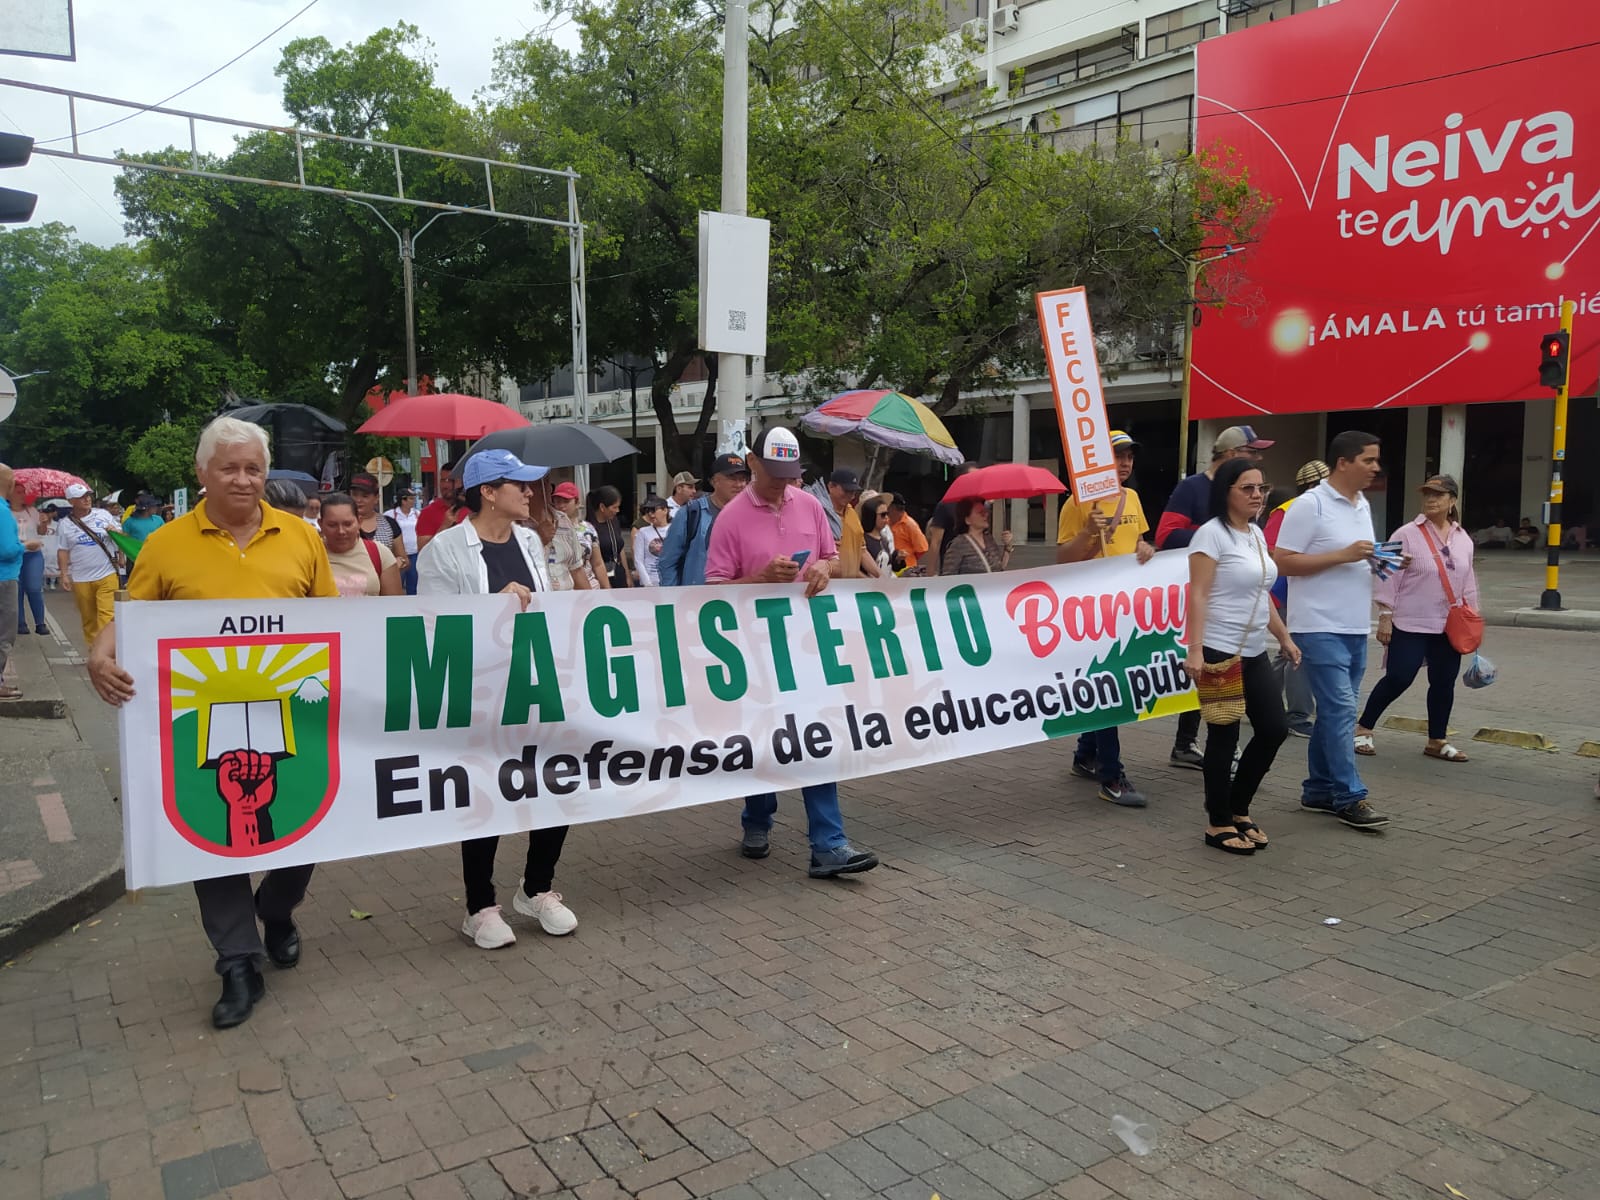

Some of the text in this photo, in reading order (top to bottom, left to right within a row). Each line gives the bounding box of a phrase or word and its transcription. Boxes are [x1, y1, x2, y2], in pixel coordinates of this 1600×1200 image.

[1337, 111, 1574, 200] Neiva
[1337, 171, 1600, 255] te ama
[1308, 307, 1447, 347] ¡ÁMALA
[1456, 304, 1485, 327] tú
[1056, 302, 1098, 469] FECODE
[771, 446, 799, 458] PETRO
[219, 614, 284, 635] ADIH
[384, 583, 992, 733] MAGISTERIO
[375, 754, 471, 820] En
[498, 734, 754, 802] defensa
[772, 713, 834, 765] de
[845, 704, 893, 752] la
[904, 667, 1121, 741] educación
